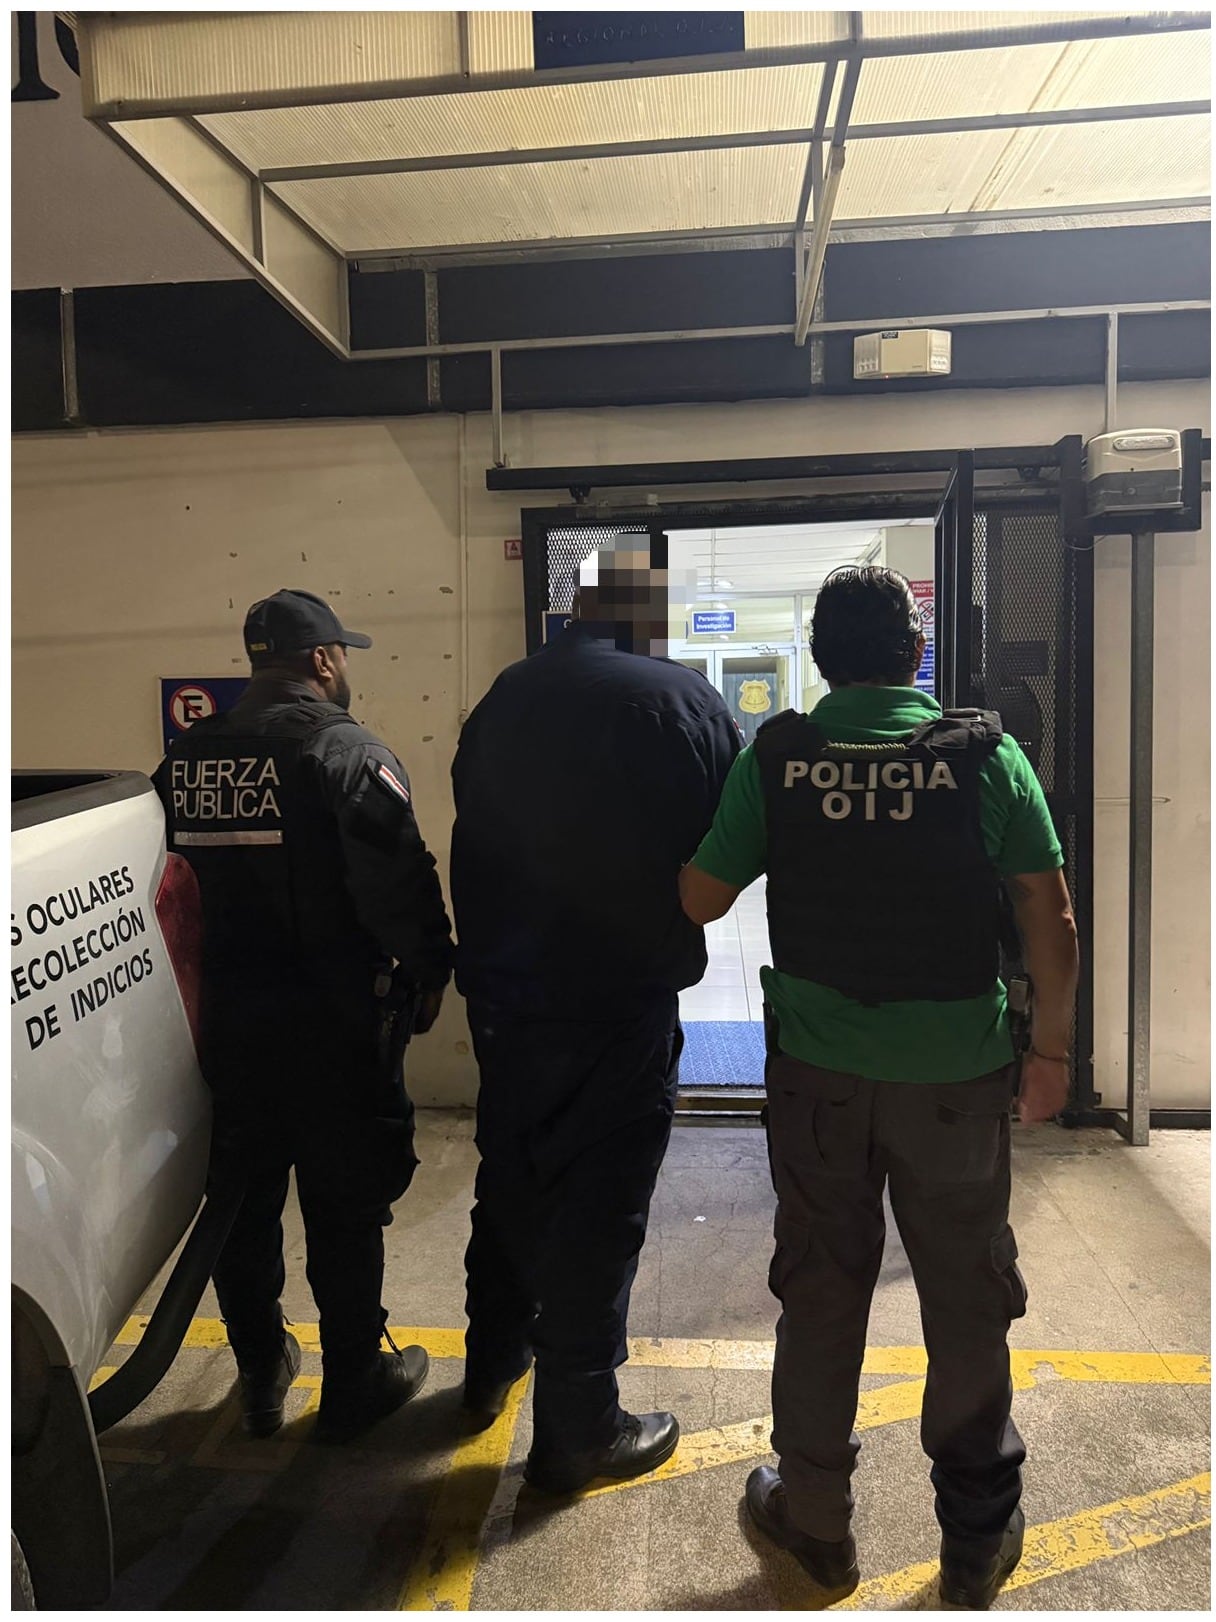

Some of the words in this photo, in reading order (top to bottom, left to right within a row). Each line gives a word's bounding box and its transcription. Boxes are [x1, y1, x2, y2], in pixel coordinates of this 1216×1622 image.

[172, 757, 280, 789] FUERZA
[784, 760, 958, 790] POLICIA
[173, 788, 281, 819] PUBLICA
[26, 866, 134, 935] OCULARES
[11, 907, 146, 1005] ECOLECCIÓN
[25, 1004, 61, 1051] DE
[70, 948, 153, 1022] INDICIOS
